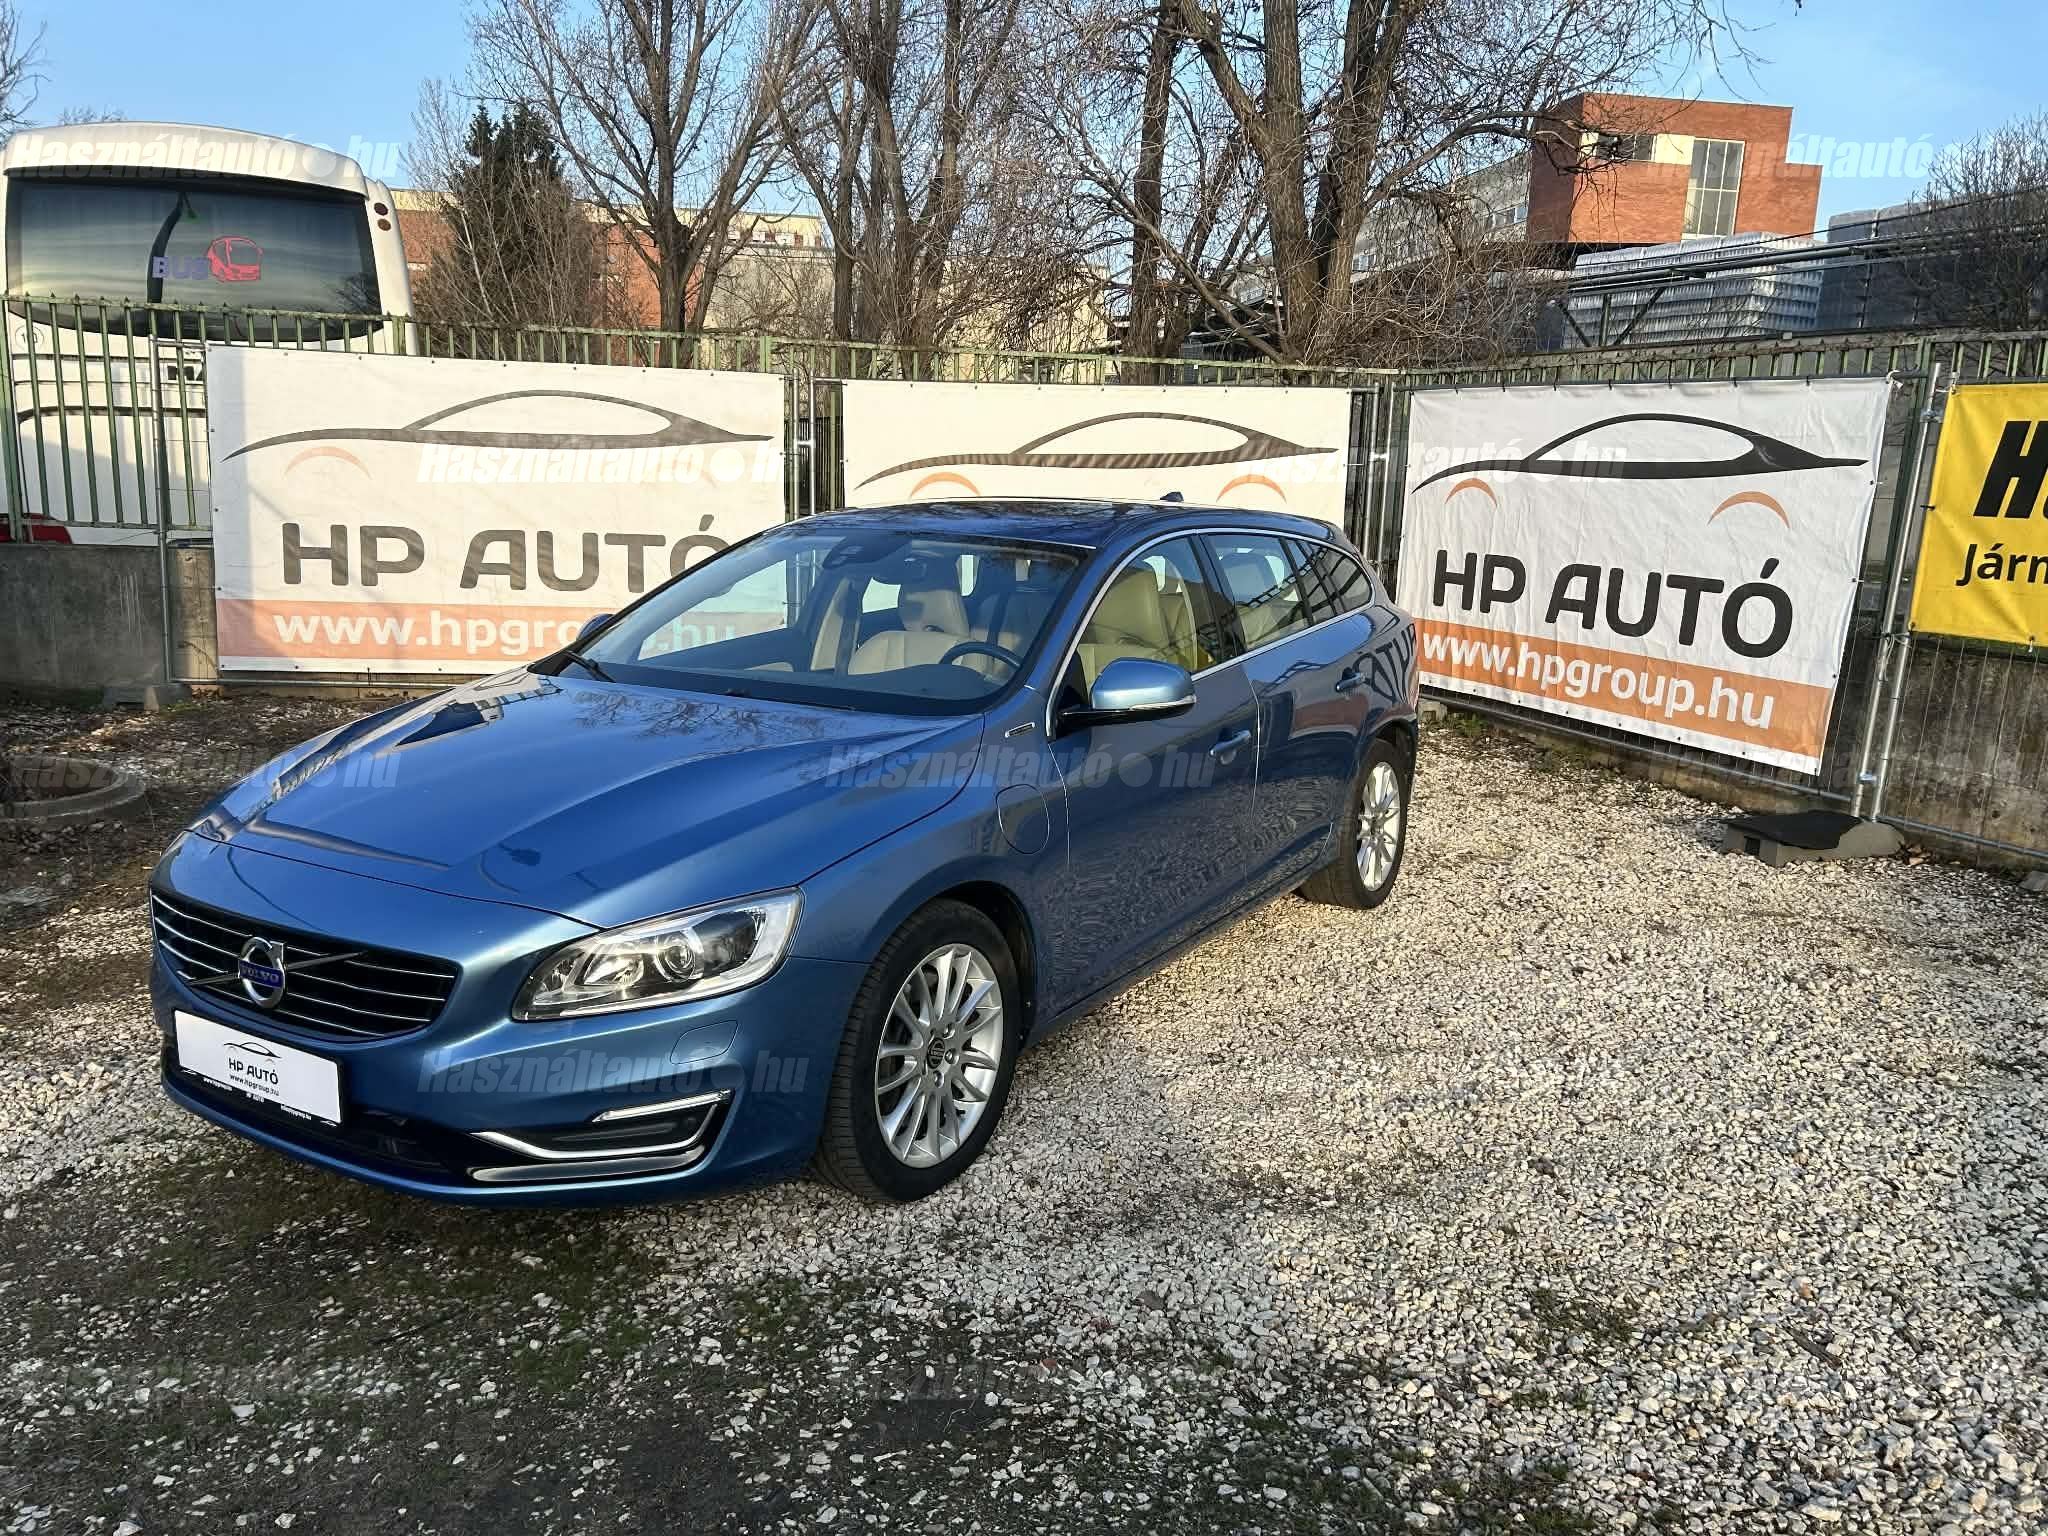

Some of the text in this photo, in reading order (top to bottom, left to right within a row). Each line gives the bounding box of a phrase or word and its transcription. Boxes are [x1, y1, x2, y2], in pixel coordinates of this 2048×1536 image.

[152, 256, 209, 280] BUS
[282, 522, 425, 587] HP
[1432, 549, 1793, 658] HP AUTÓ
[1422, 632, 1775, 729] www.hpgroup.hu
[242, 965, 280, 983] VOLVO
[228, 1058, 244, 1072] HP
[246, 1065, 279, 1085] AUTÓ
